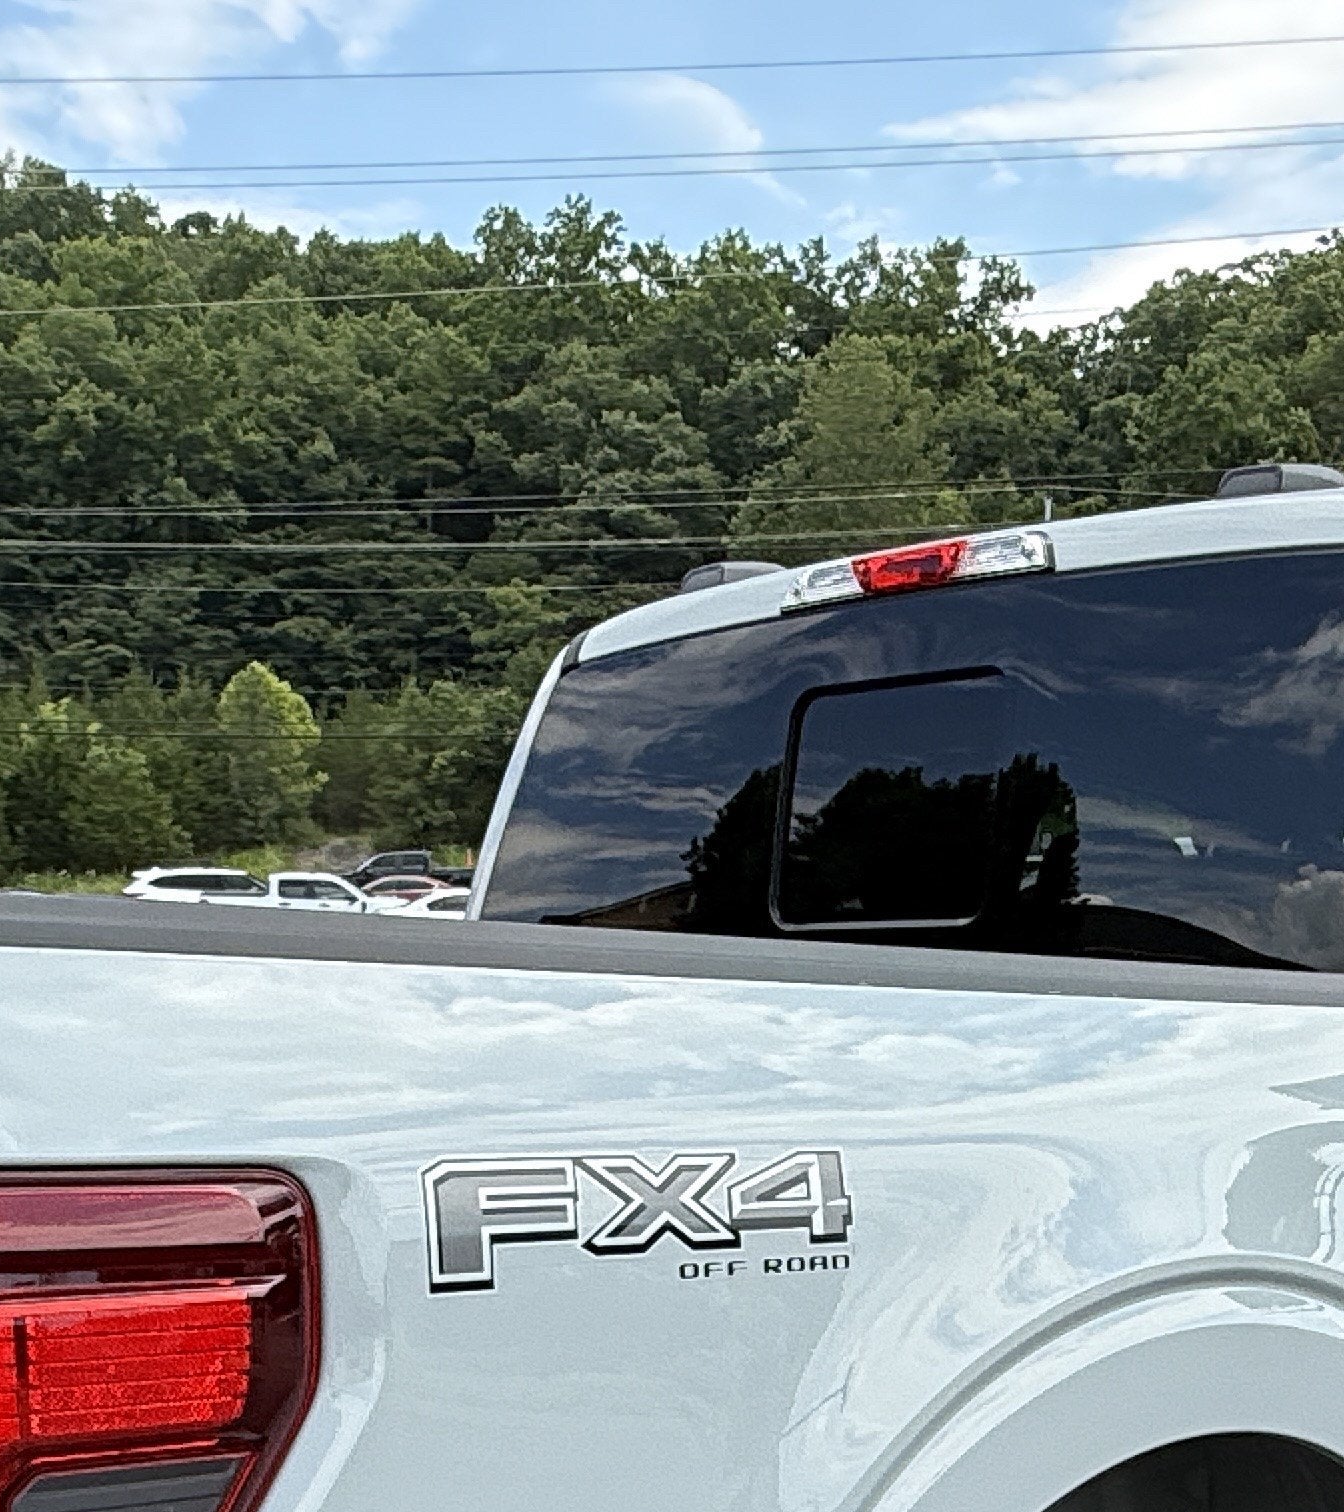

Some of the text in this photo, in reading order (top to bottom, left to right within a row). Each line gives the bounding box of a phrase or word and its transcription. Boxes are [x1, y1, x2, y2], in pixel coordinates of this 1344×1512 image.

[419, 1148, 853, 1295] FX4
[678, 1253, 851, 1280] OFF ROAD
